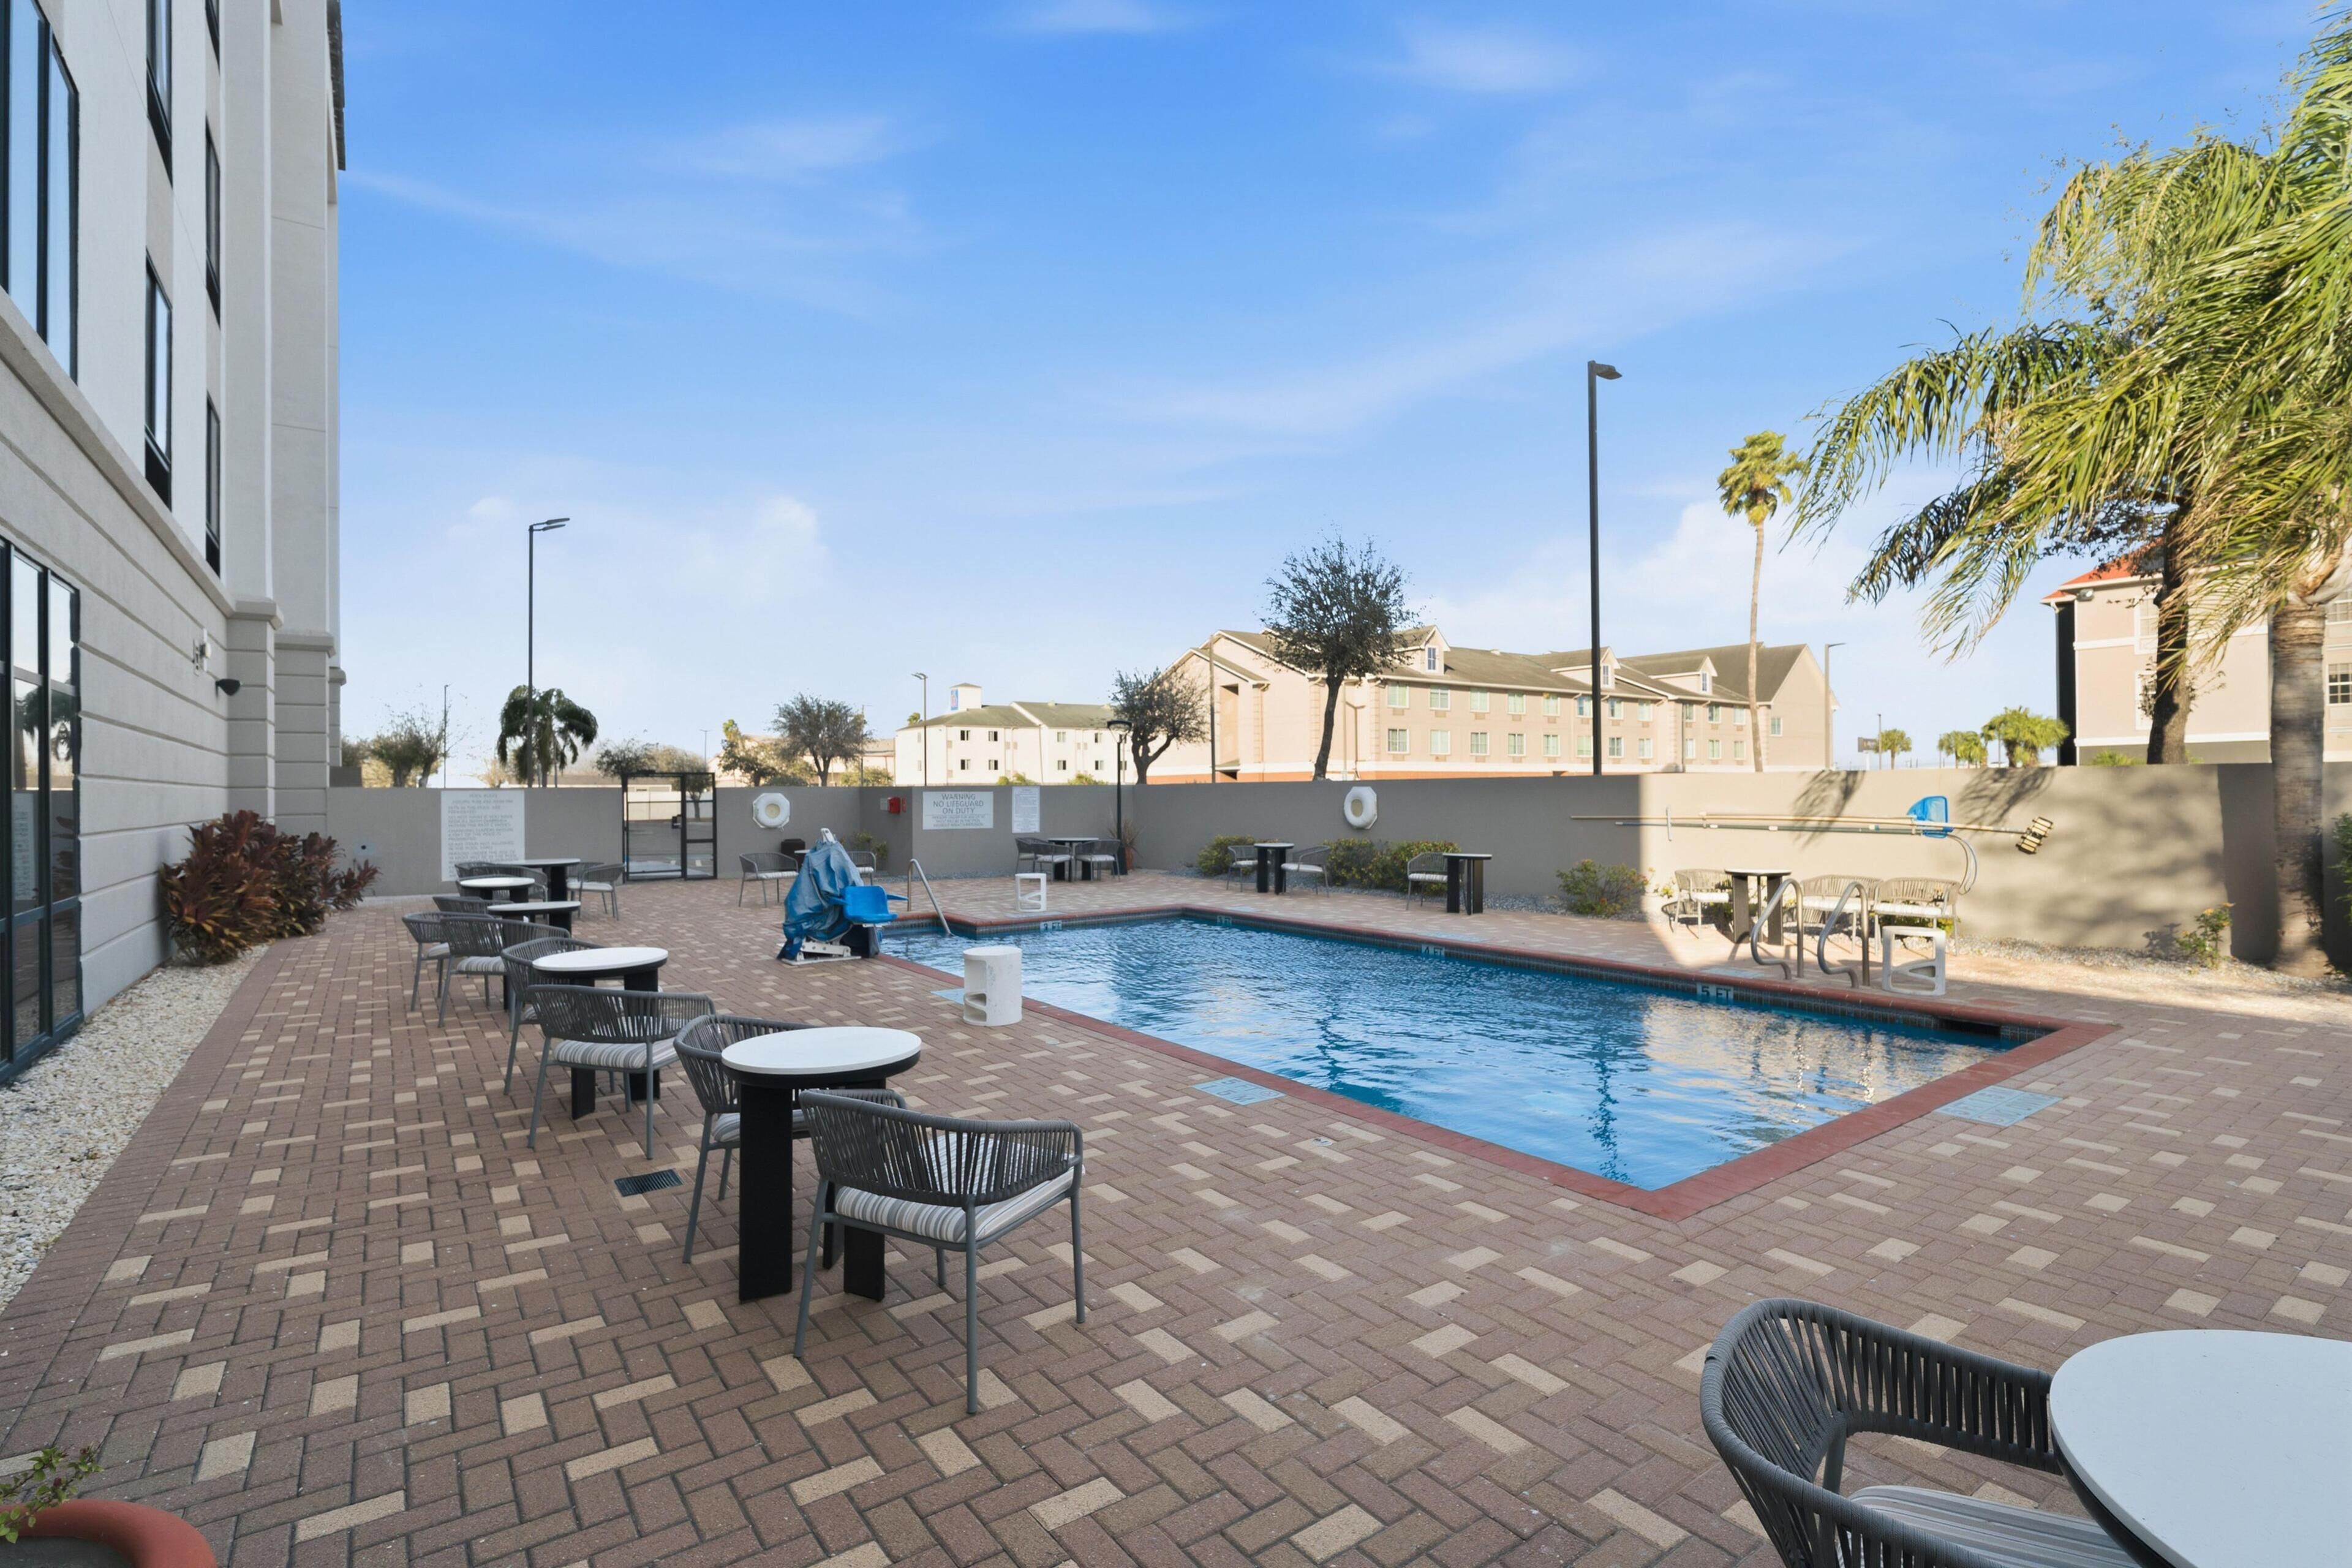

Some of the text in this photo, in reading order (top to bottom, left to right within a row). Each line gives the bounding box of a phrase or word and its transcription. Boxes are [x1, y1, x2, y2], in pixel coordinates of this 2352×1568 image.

[1433, 947, 1443, 956] FT
[1702, 986, 1732, 1000] 5 FT
